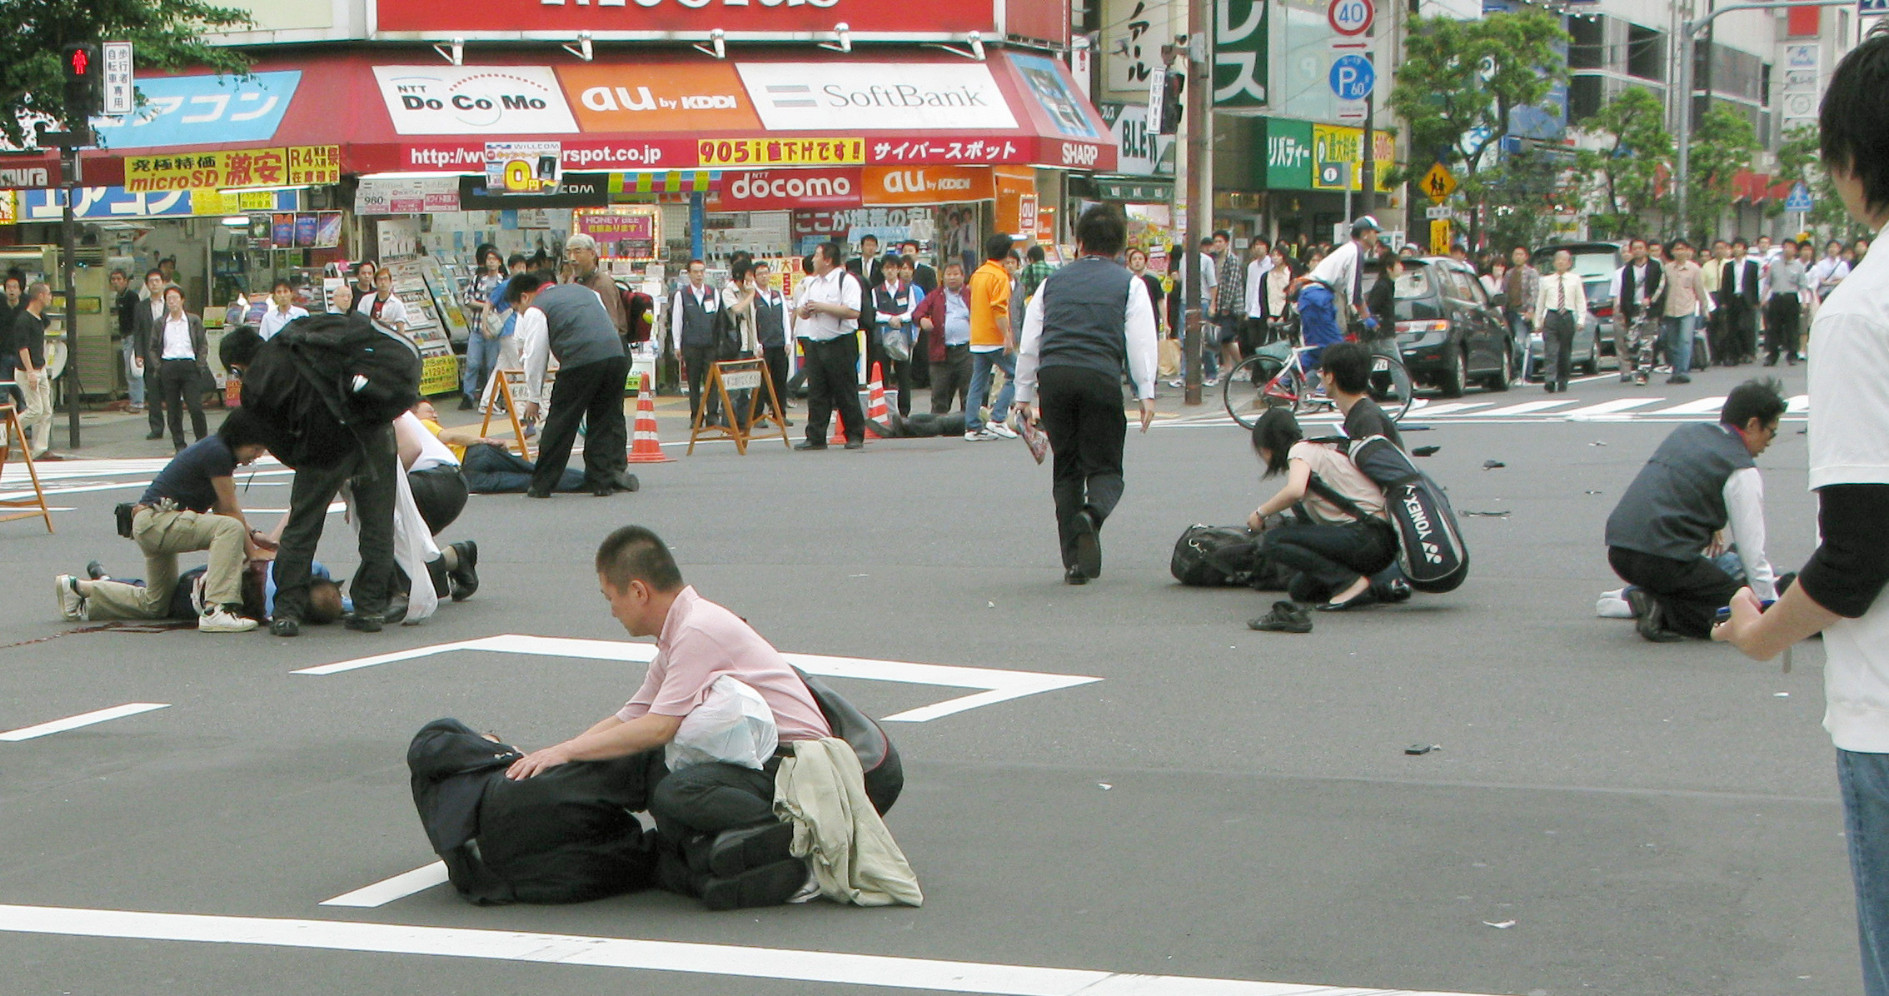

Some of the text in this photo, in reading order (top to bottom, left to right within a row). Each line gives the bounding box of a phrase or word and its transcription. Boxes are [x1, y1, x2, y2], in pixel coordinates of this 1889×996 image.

[1338, 3, 1363, 23] 40
[107, 49, 118, 83] 自転車
[118, 49, 129, 83] 歩行者
[397, 85, 426, 93] NTT
[1338, 67, 1357, 97] P
[1351, 82, 1365, 96] 60
[113, 86, 124, 109] 専用
[581, 86, 738, 112] au by KDDI
[823, 84, 988, 108] SoftBank
[291, 149, 313, 168] R4
[874, 140, 1017, 161] サイバースポット
[1061, 142, 1098, 165] SHARP
[224, 151, 282, 186] 激安
[752, 171, 769, 179] NTT
[129, 169, 219, 192] microSD
[731, 172, 851, 199] docomo
[883, 170, 926, 193] au
[937, 177, 971, 191] KDDI
[586, 216, 620, 224] HONEY
[1403, 493, 1433, 541] YONEX
